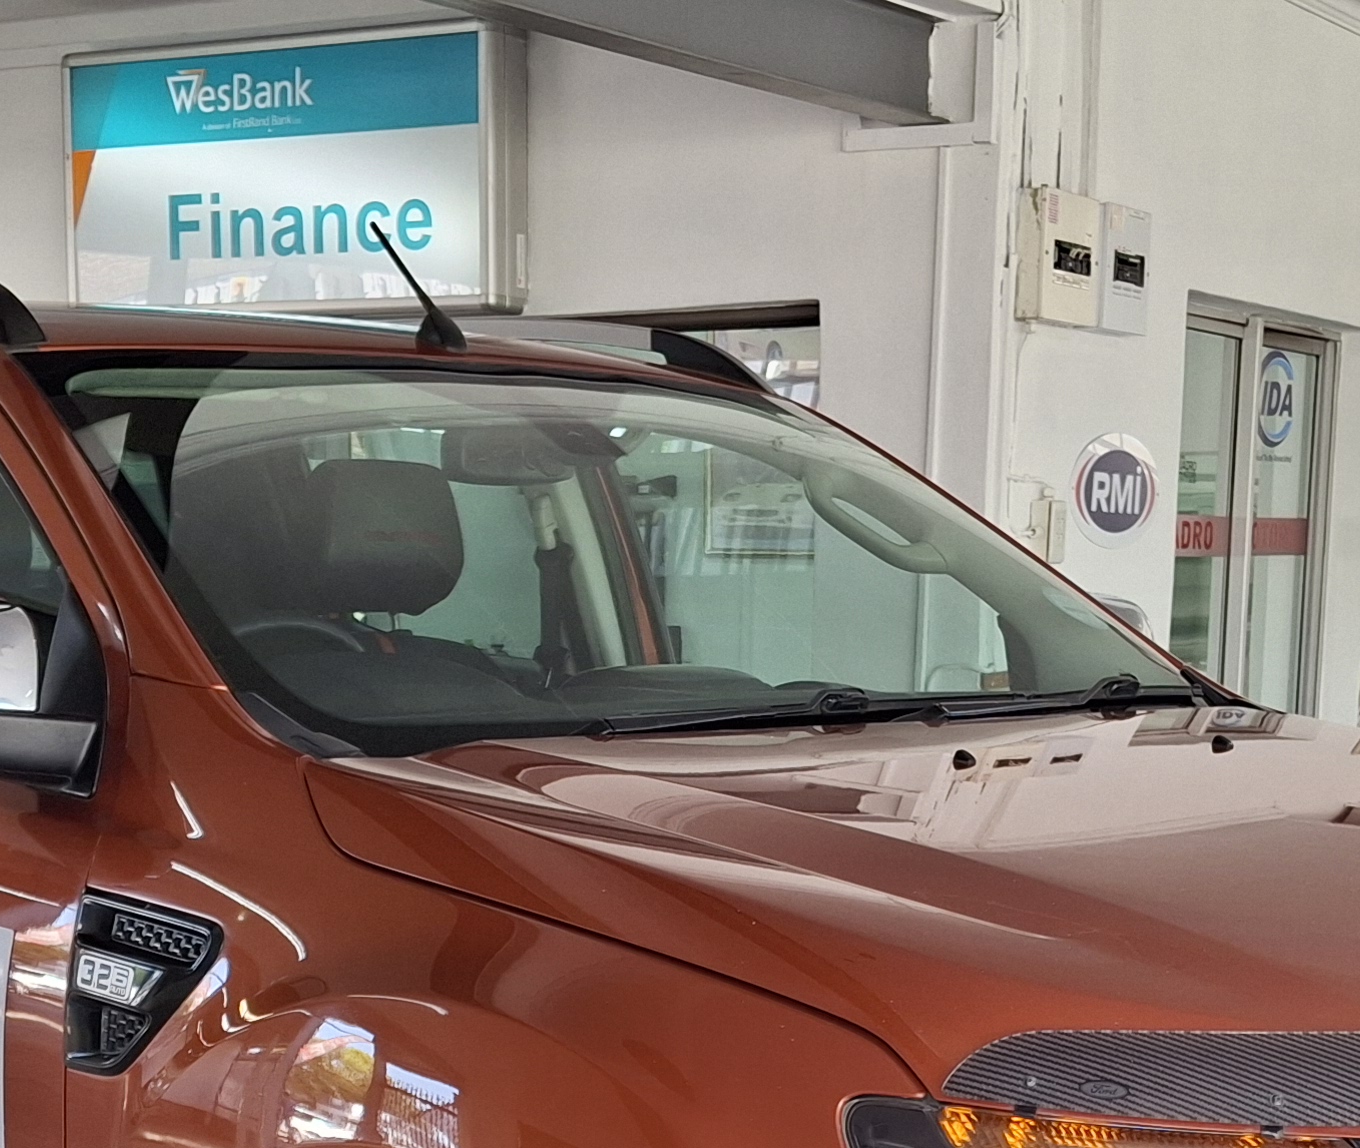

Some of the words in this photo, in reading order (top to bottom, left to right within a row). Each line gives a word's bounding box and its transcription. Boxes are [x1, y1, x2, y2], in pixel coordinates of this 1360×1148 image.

[166, 66, 314, 115] WesBank
[168, 192, 433, 260] Finance
[1260, 380, 1293, 418] IDA
[1175, 520, 1214, 551] DRO
[1090, 1083, 1119, 1096] Ford
